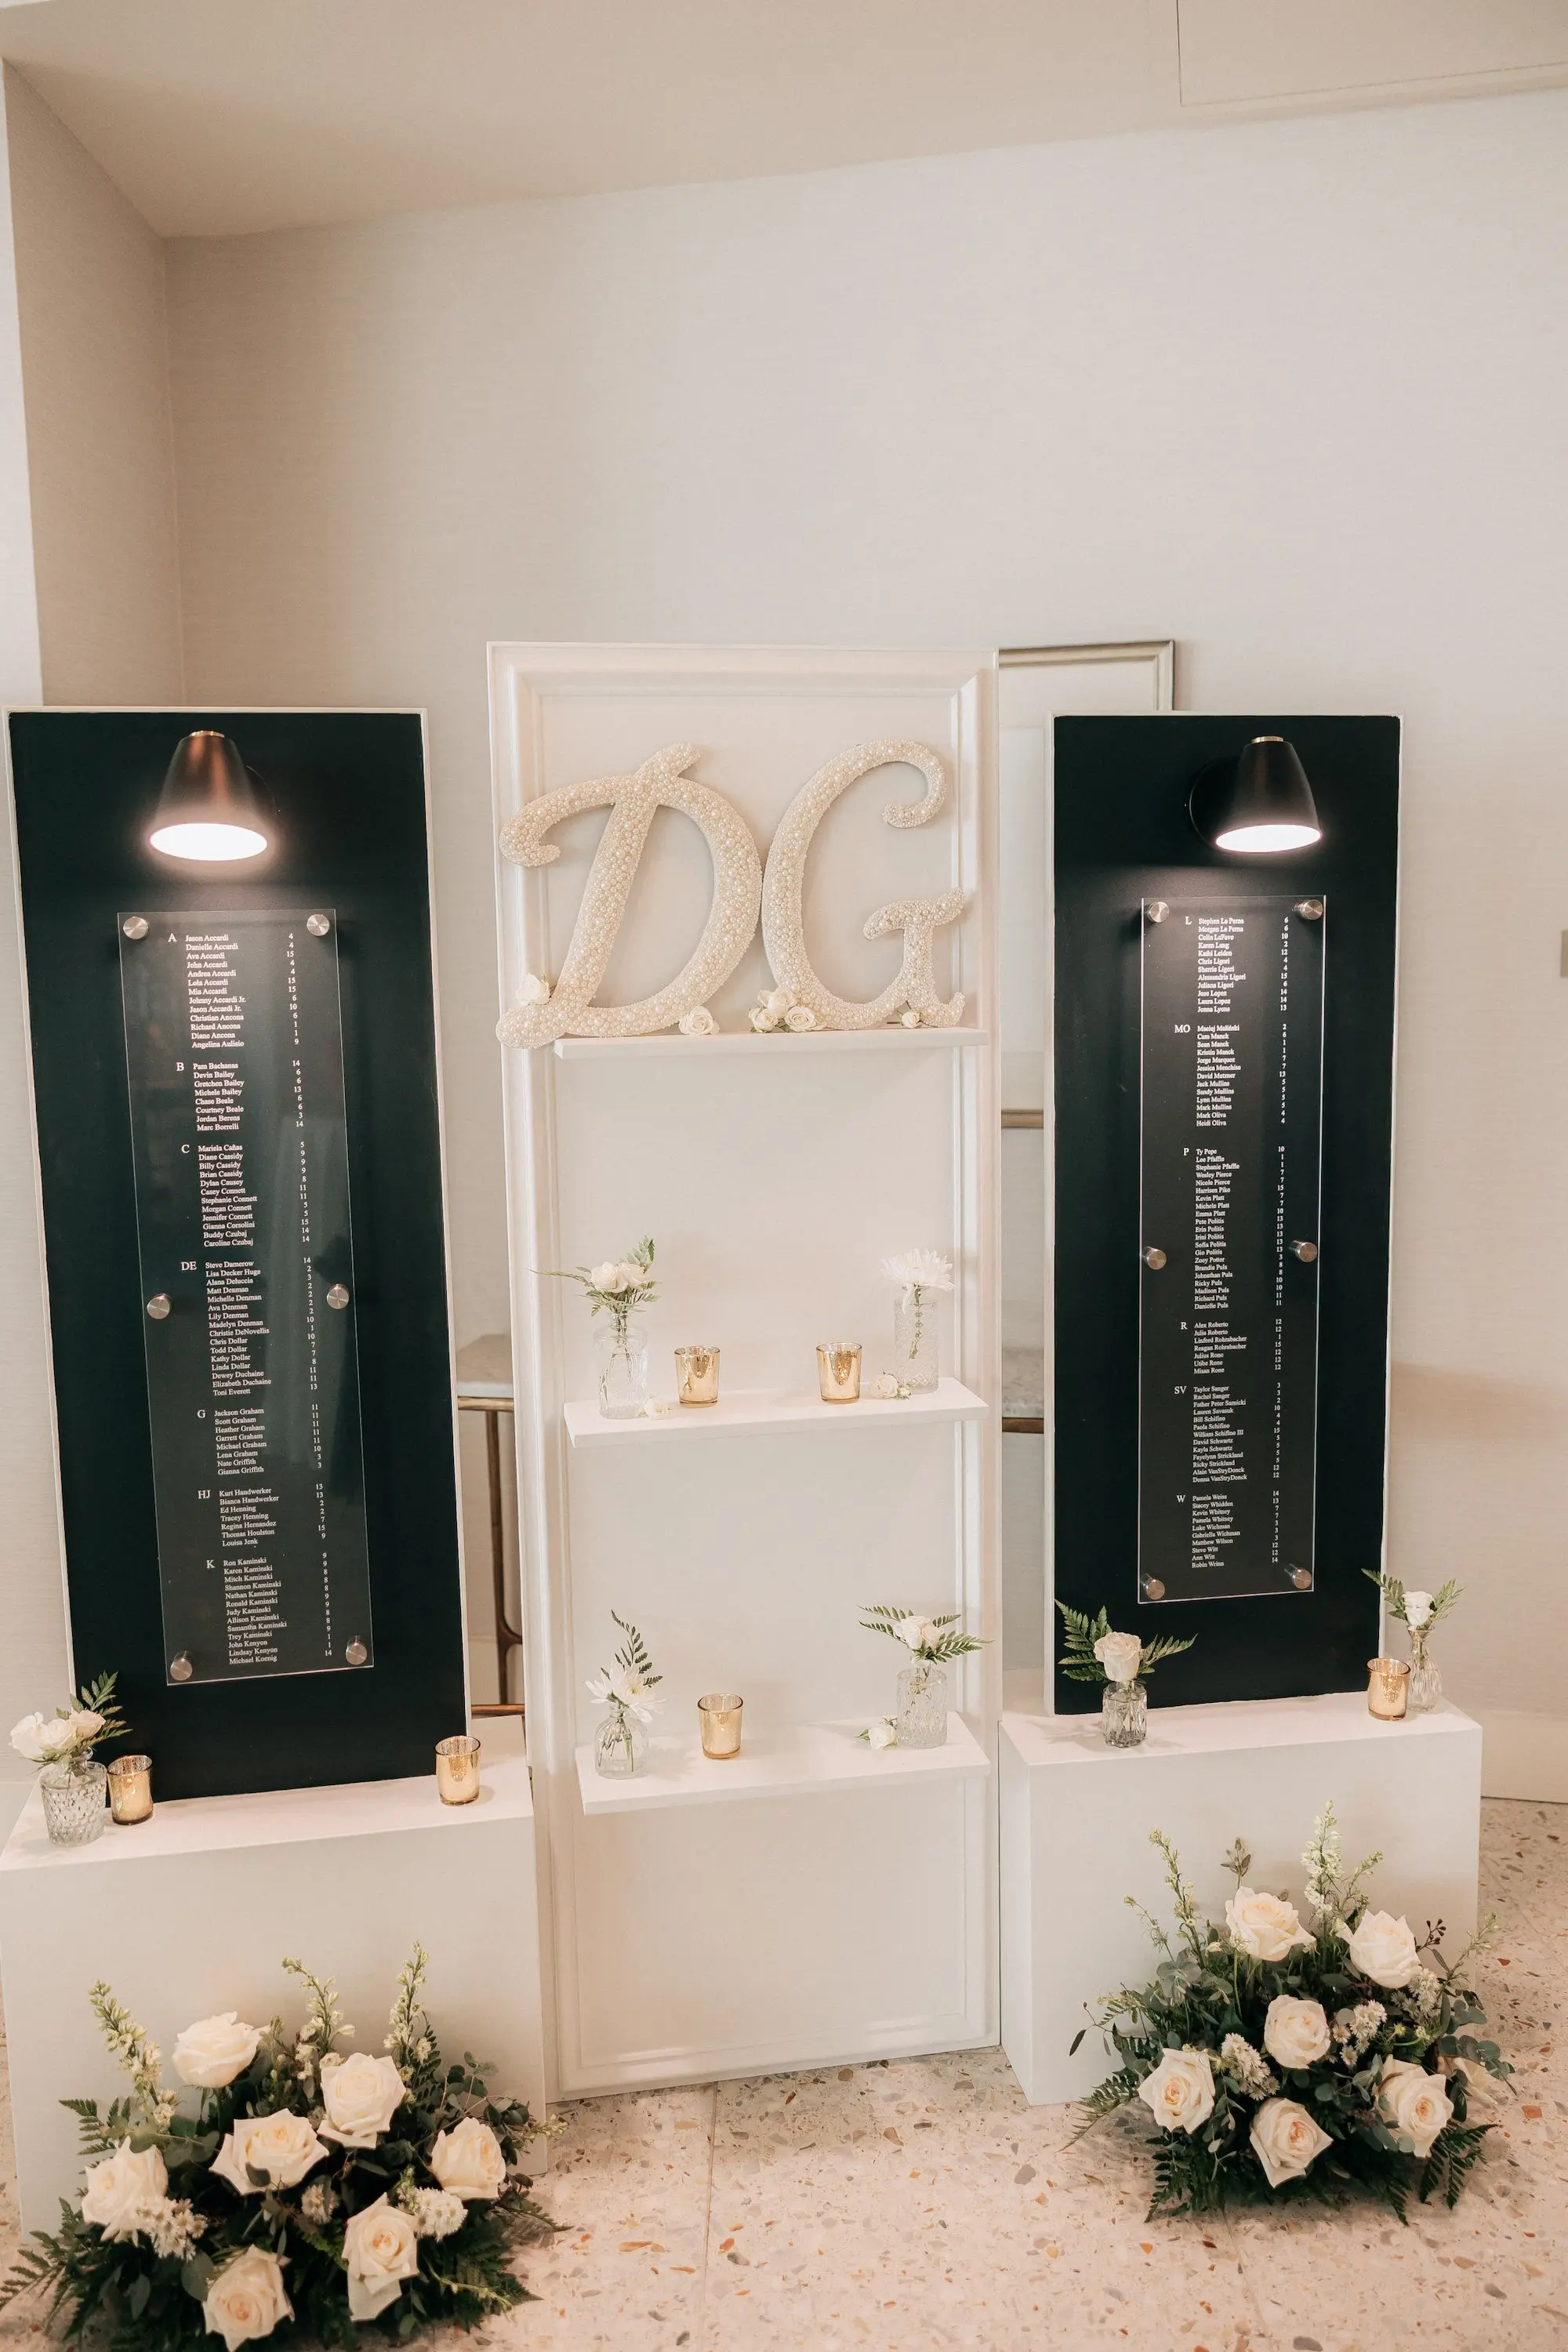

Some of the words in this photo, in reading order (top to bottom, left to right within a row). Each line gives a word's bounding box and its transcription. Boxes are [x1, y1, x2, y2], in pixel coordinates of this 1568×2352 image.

[1185, 916, 1192, 925] L
[167, 933, 177, 942] A
[188, 996, 212, 1005] Johnny
[1174, 1023, 1191, 1033] MO
[191, 1040, 221, 1050] Angelina
[176, 1062, 185, 1071] B
[214, 1070, 235, 1080] Bailey
[222, 1088, 242, 1097] Bailey
[195, 1105, 225, 1115] Courtney
[181, 1144, 190, 1153] C
[1183, 1146, 1189, 1156] P
[1196, 1148, 1203, 1156] Ty
[199, 1162, 216, 1171] Billy
[216, 1161, 241, 1171] Cassidy
[201, 1196, 232, 1206] Stephanie
[202, 1214, 228, 1222] Jennifer
[181, 1261, 198, 1270] DE
[207, 1294, 235, 1303] Michelle
[1181, 1321, 1188, 1330] R
[212, 1379, 241, 1388] Elizabeth
[242, 1377, 272, 1386] Duchaine
[1174, 1385, 1187, 1394] SV
[1193, 1385, 1210, 1394] Taylor
[1211, 1385, 1229, 1393] Sanger
[197, 1409, 206, 1418] G
[214, 1409, 238, 1417] Jackson
[198, 1490, 211, 1499] HJ
[234, 1486, 272, 1496] Handwerker
[1176, 1494, 1185, 1503] W
[230, 1504, 257, 1514] Henning
[247, 1528, 275, 1537] Houlston
[206, 1559, 215, 1568] K
[238, 1557, 267, 1566] Kaminski
[244, 1573, 273, 1581] Kaminski
[224, 1583, 252, 1592] Shannon
[252, 1581, 281, 1589] Kaminski
